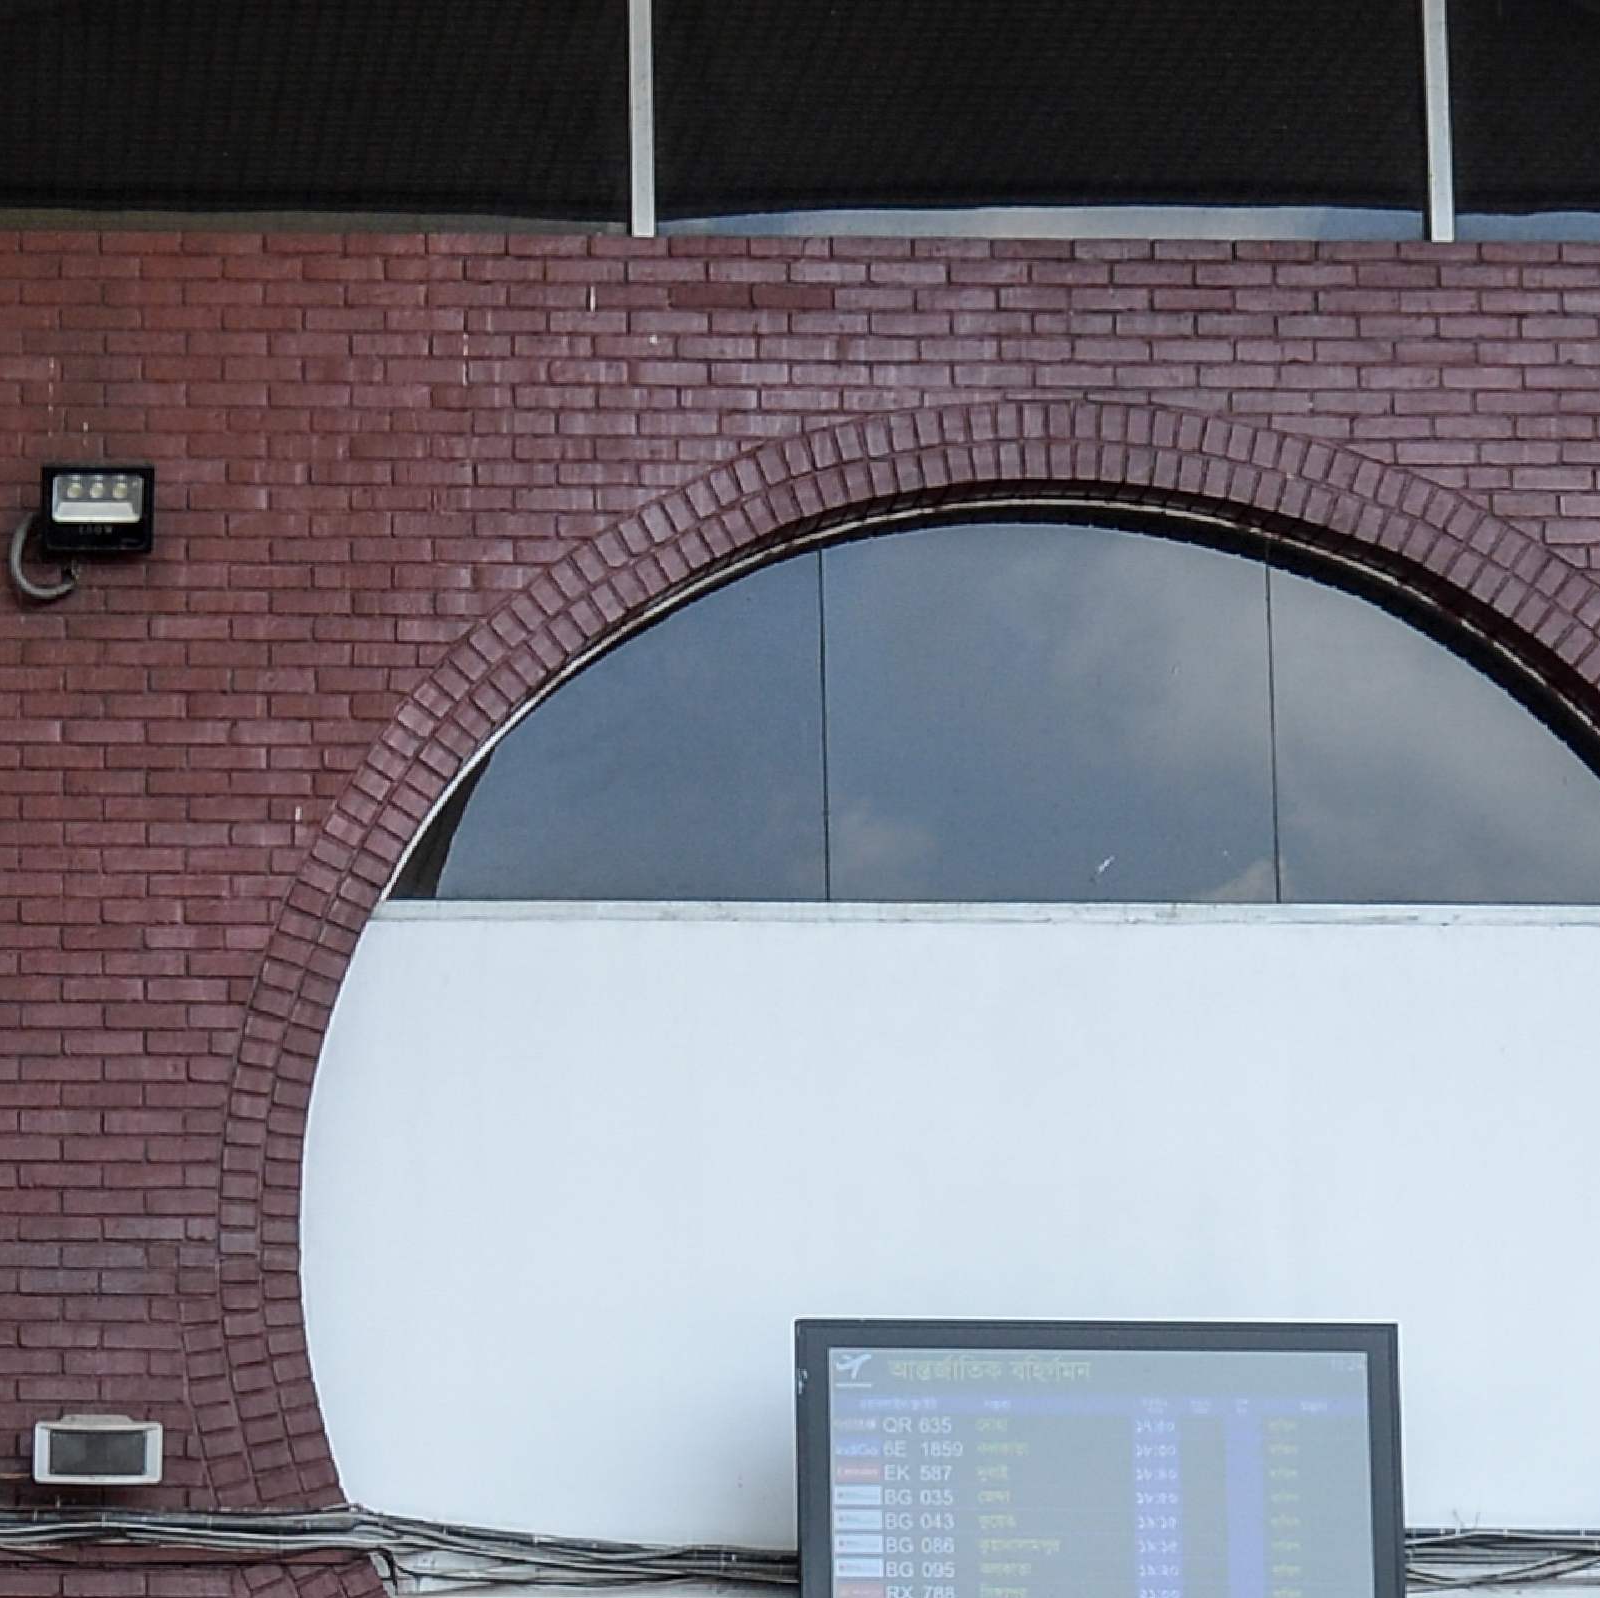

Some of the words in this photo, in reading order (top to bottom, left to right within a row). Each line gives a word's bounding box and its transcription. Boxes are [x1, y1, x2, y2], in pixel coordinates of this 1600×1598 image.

[883, 1416, 912, 1434] QR
[918, 1416, 952, 1434] 635
[883, 1440, 907, 1458] 6E
[920, 1440, 964, 1458] 1859
[884, 1464, 910, 1481] EK
[920, 1464, 953, 1481] 587
[884, 1488, 912, 1506] BG
[920, 1488, 954, 1506] 035
[885, 1512, 913, 1530] BG
[920, 1512, 955, 1530] 043
[885, 1537, 914, 1554] BG
[885, 1561, 914, 1578] BG
[922, 1561, 956, 1578] 095
